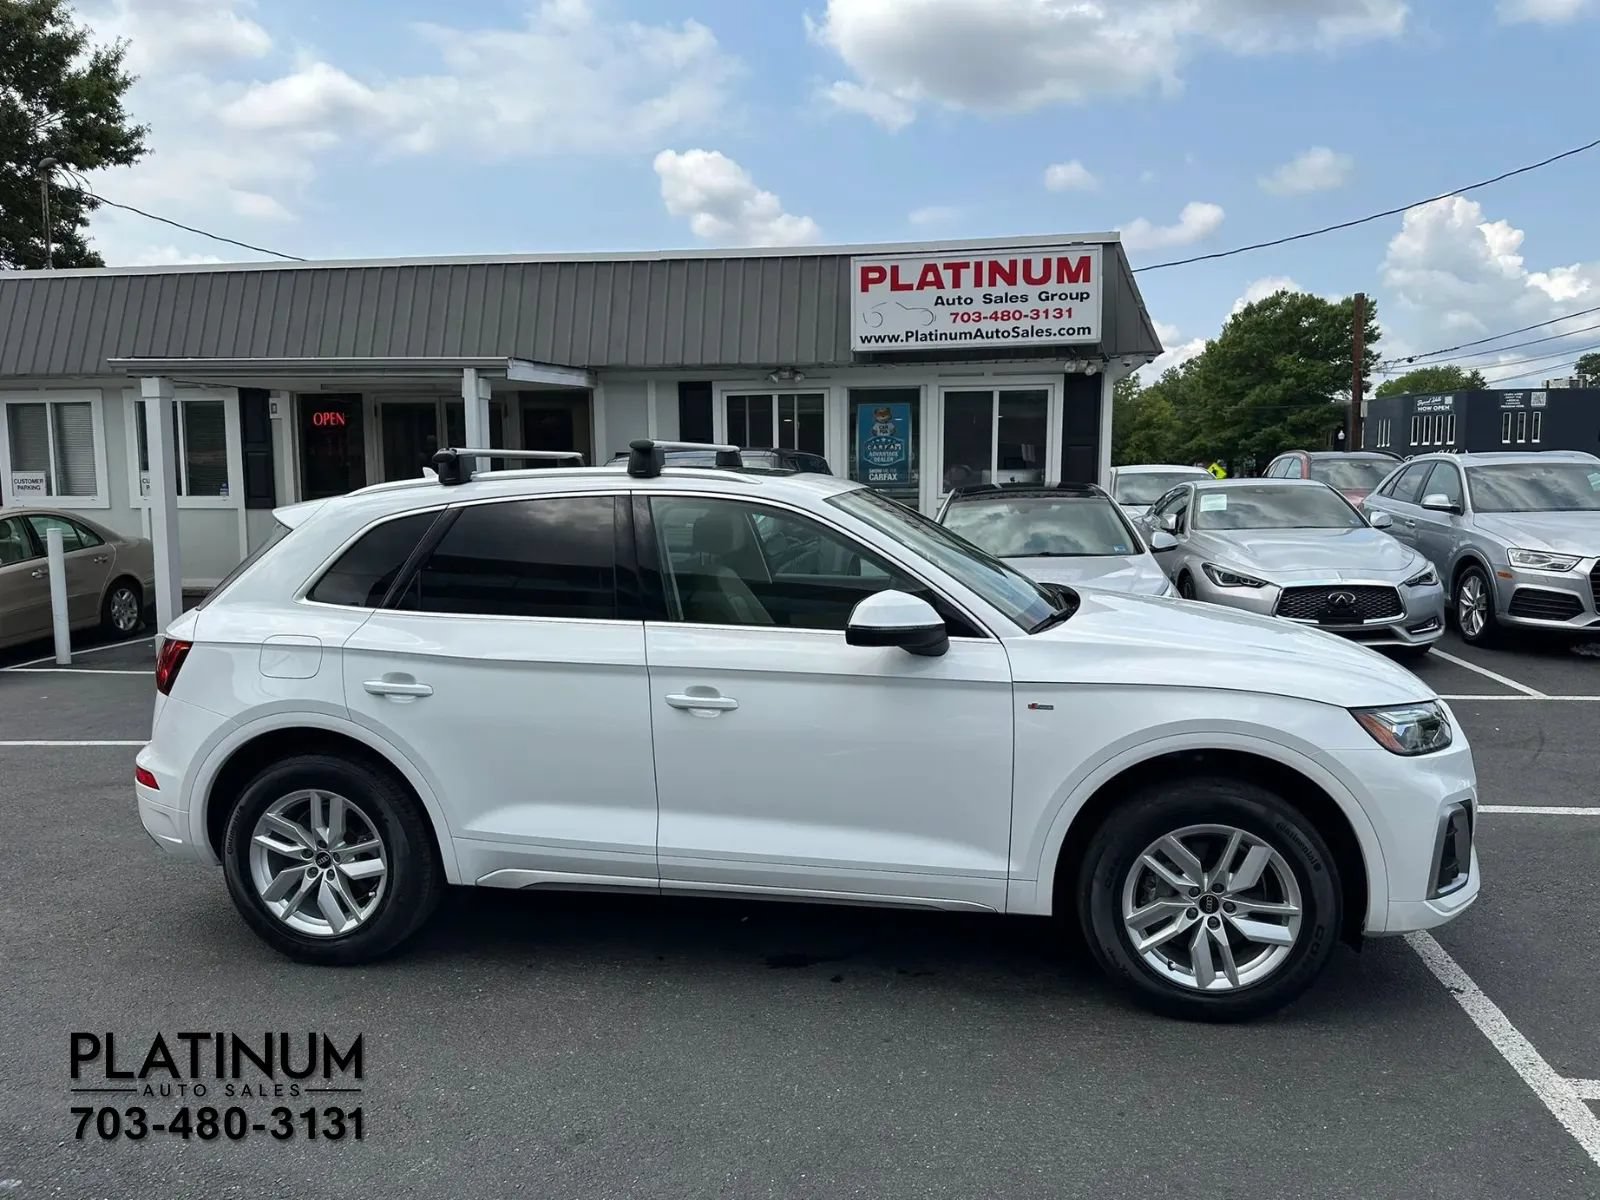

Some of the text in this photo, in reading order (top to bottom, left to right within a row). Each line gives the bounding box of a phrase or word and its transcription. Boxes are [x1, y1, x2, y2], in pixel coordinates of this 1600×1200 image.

[860, 255, 1092, 293] PLATINUM
[934, 290, 1091, 307] Auto Sales Group
[950, 307, 1073, 324] 703-480-3131
[859, 324, 1092, 345] www.PlatinumAutoSales.com
[313, 412, 345, 426] OPEN
[868, 473, 898, 481] CARFAX
